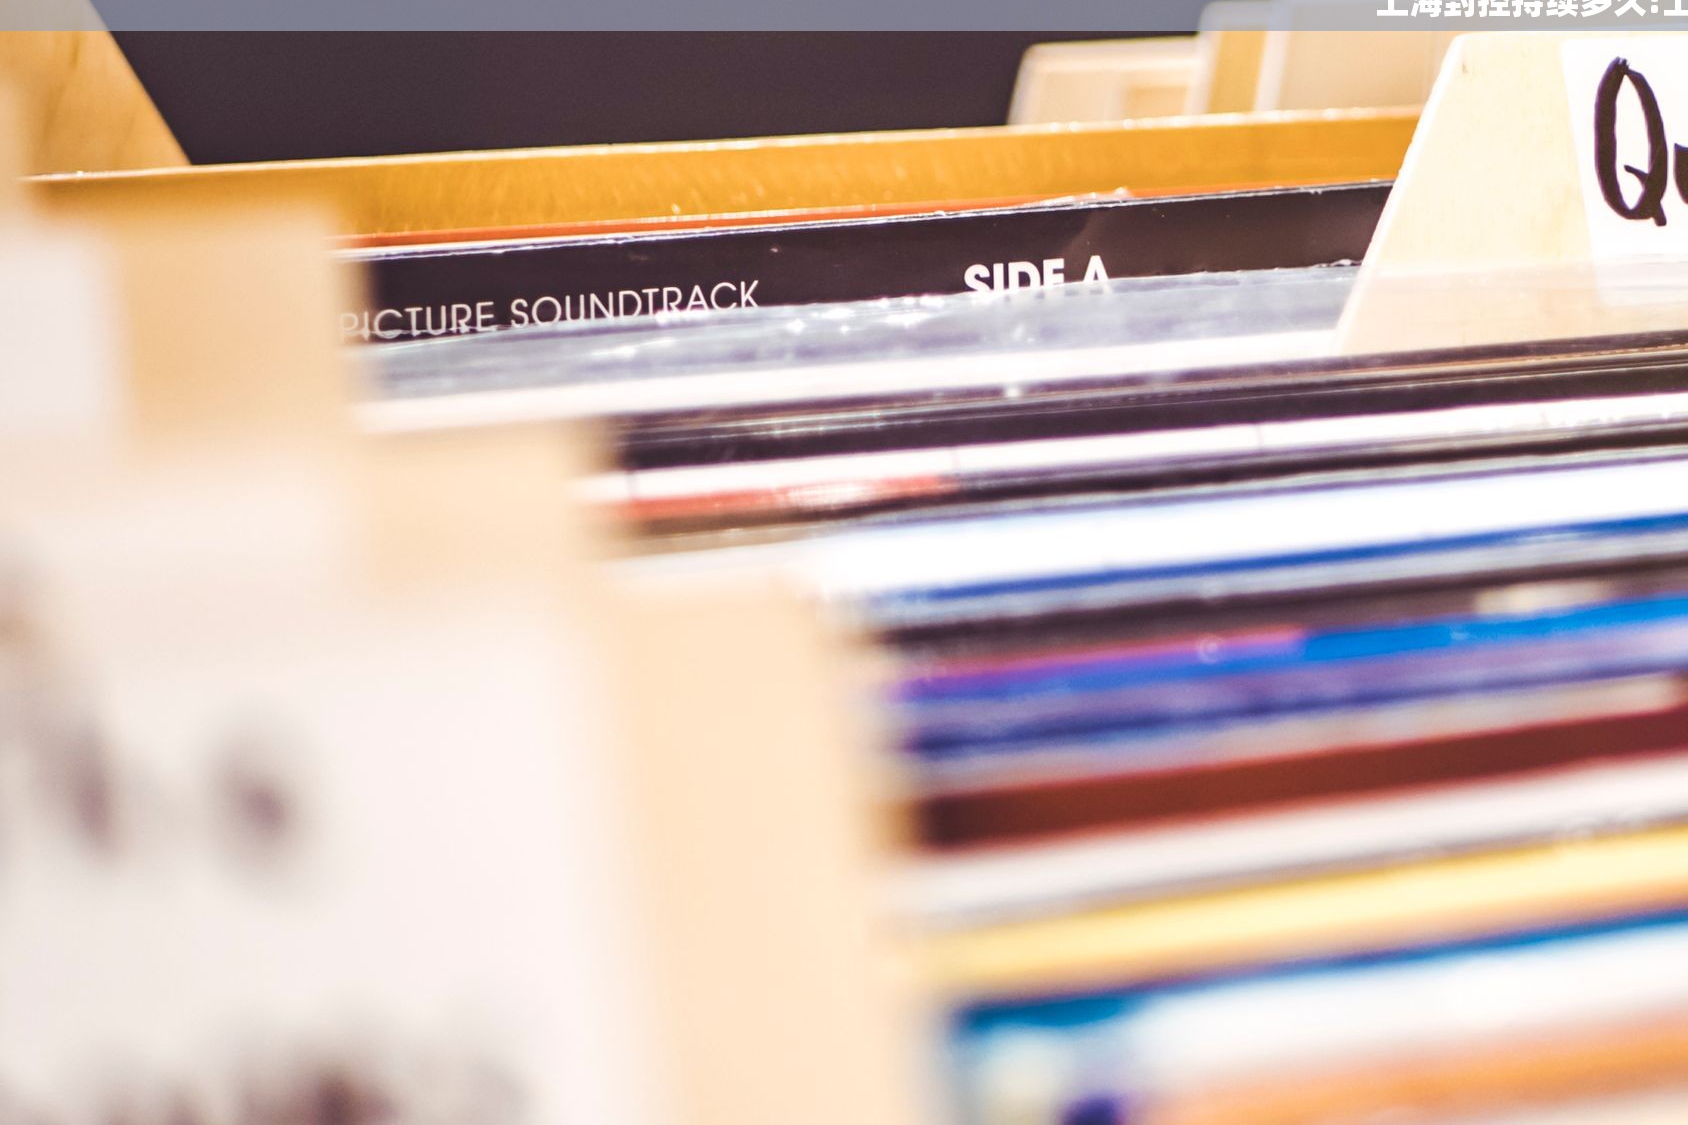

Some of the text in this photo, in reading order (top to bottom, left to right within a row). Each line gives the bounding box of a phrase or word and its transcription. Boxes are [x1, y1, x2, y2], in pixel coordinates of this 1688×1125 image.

[964, 255, 1110, 294] SIDE A
[340, 280, 759, 341] PICTURE SOUNDTRACK
